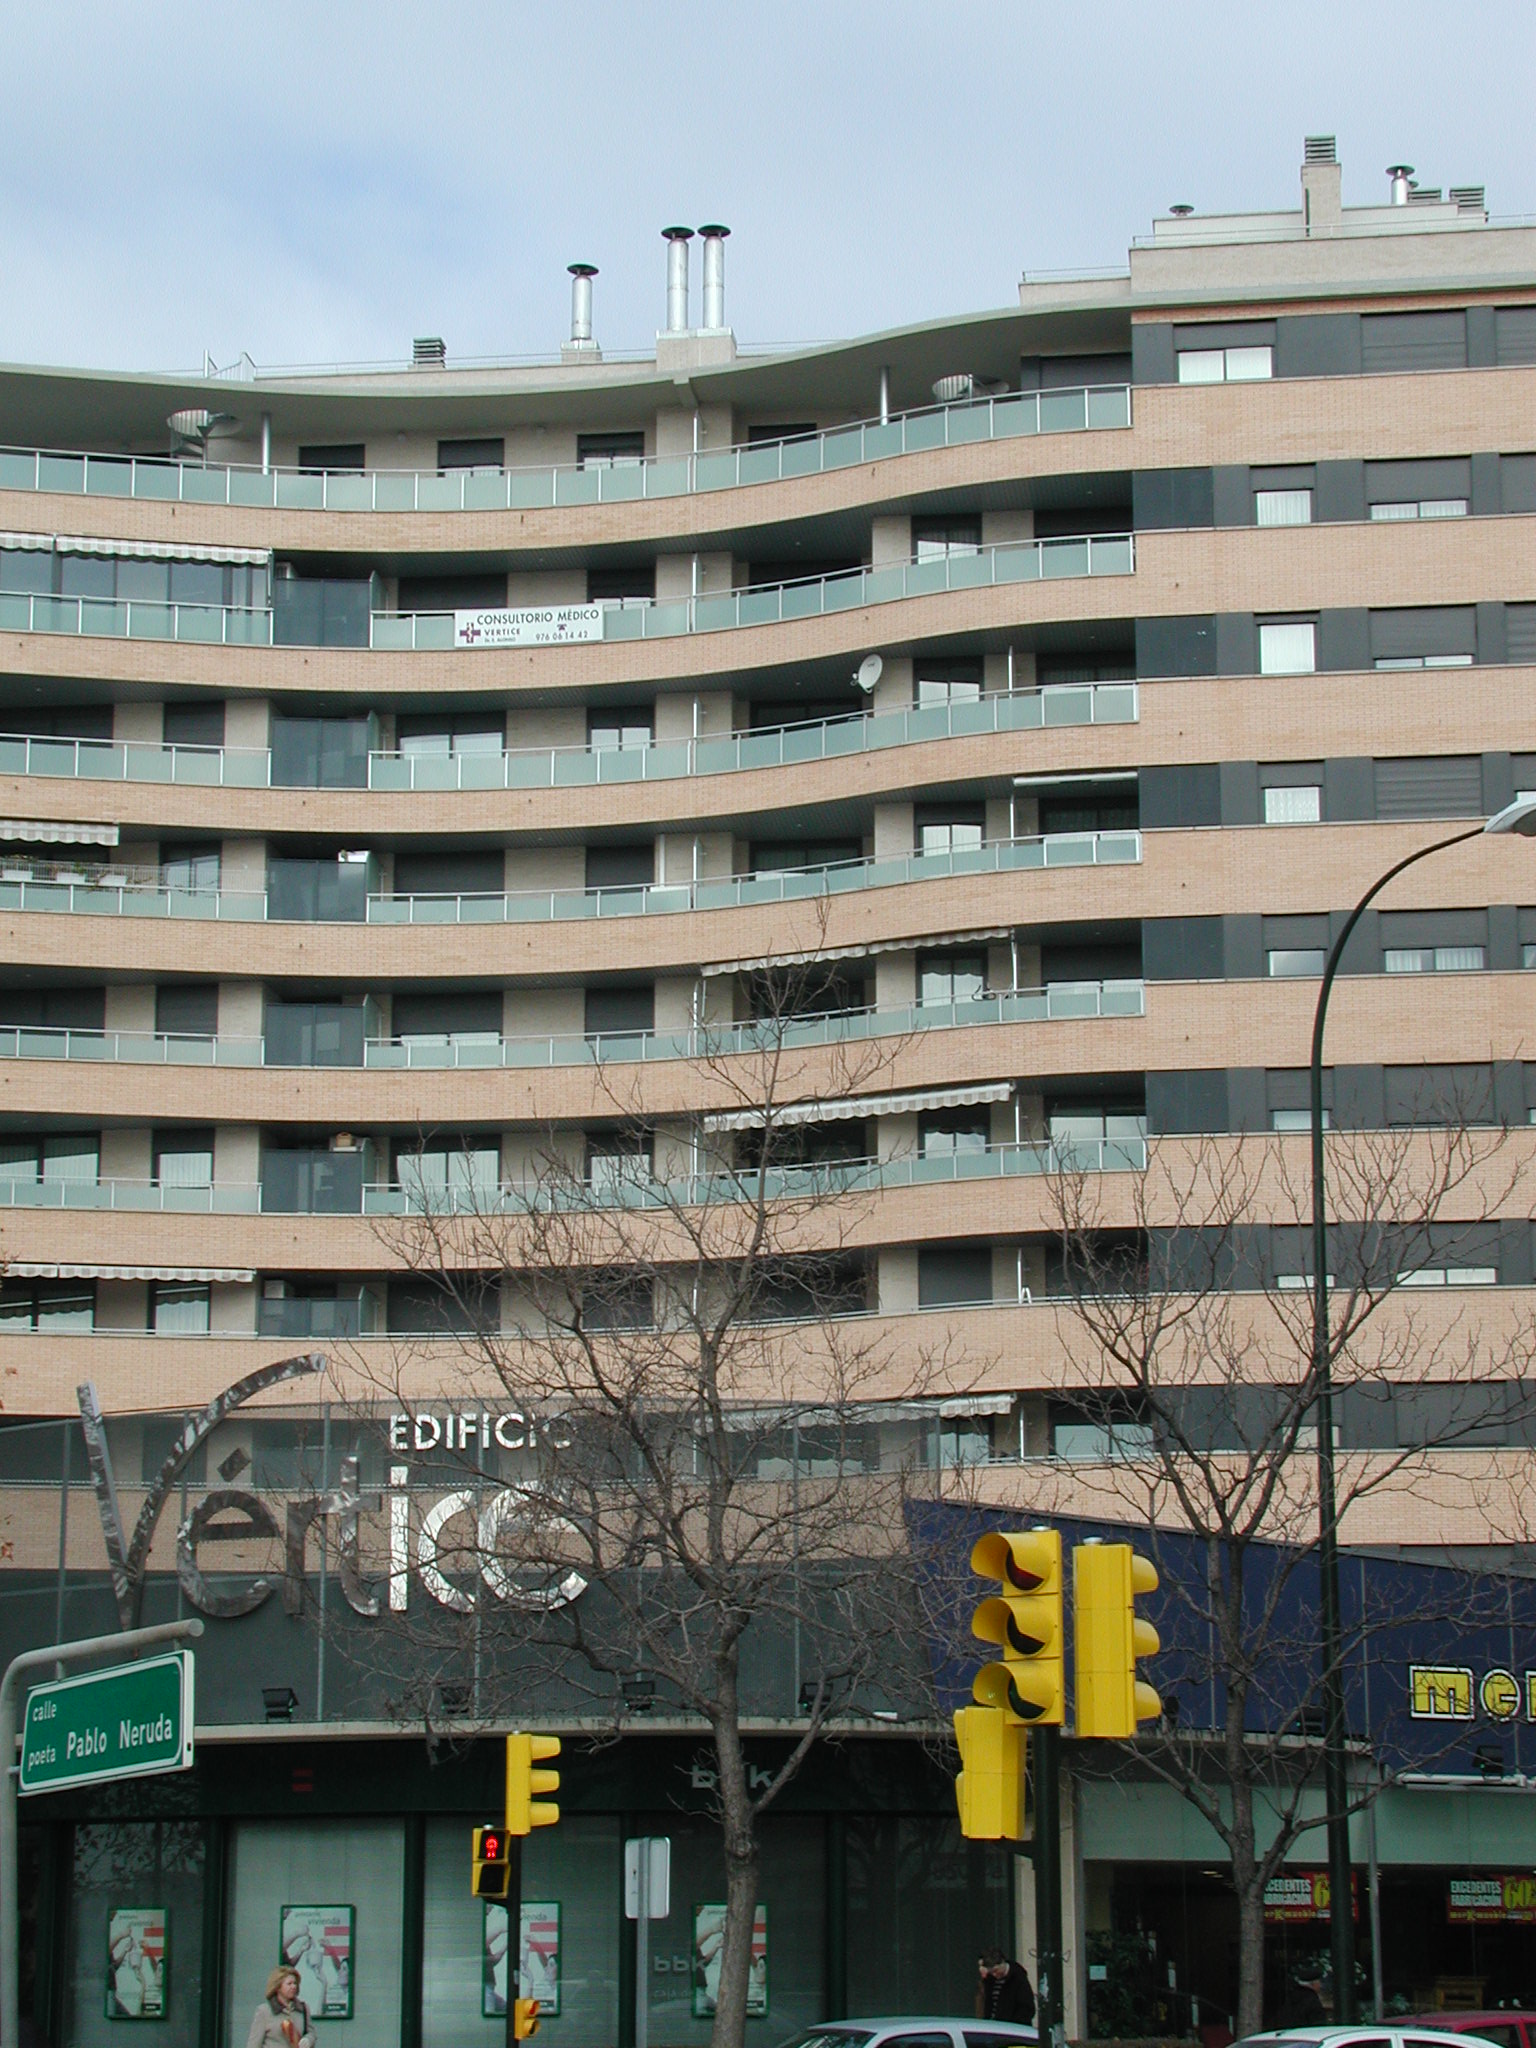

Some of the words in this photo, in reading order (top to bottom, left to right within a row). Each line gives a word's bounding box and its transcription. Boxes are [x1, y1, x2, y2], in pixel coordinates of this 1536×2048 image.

[477, 611, 553, 625] CONSULTORIO
[557, 608, 599, 621] MÉDICO
[484, 628, 520, 636] VERTICE
[536, 633, 550, 641] 976
[565, 631, 575, 640] 14
[578, 630, 588, 638] 42
[32, 1700, 57, 1722] calle
[27, 1745, 57, 1772] poeta
[66, 1726, 108, 1760] Pablo
[119, 1713, 173, 1750] Neruda
[691, 1765, 776, 1789] bk
[1450, 1880, 1502, 1894] EXCEDENTES
